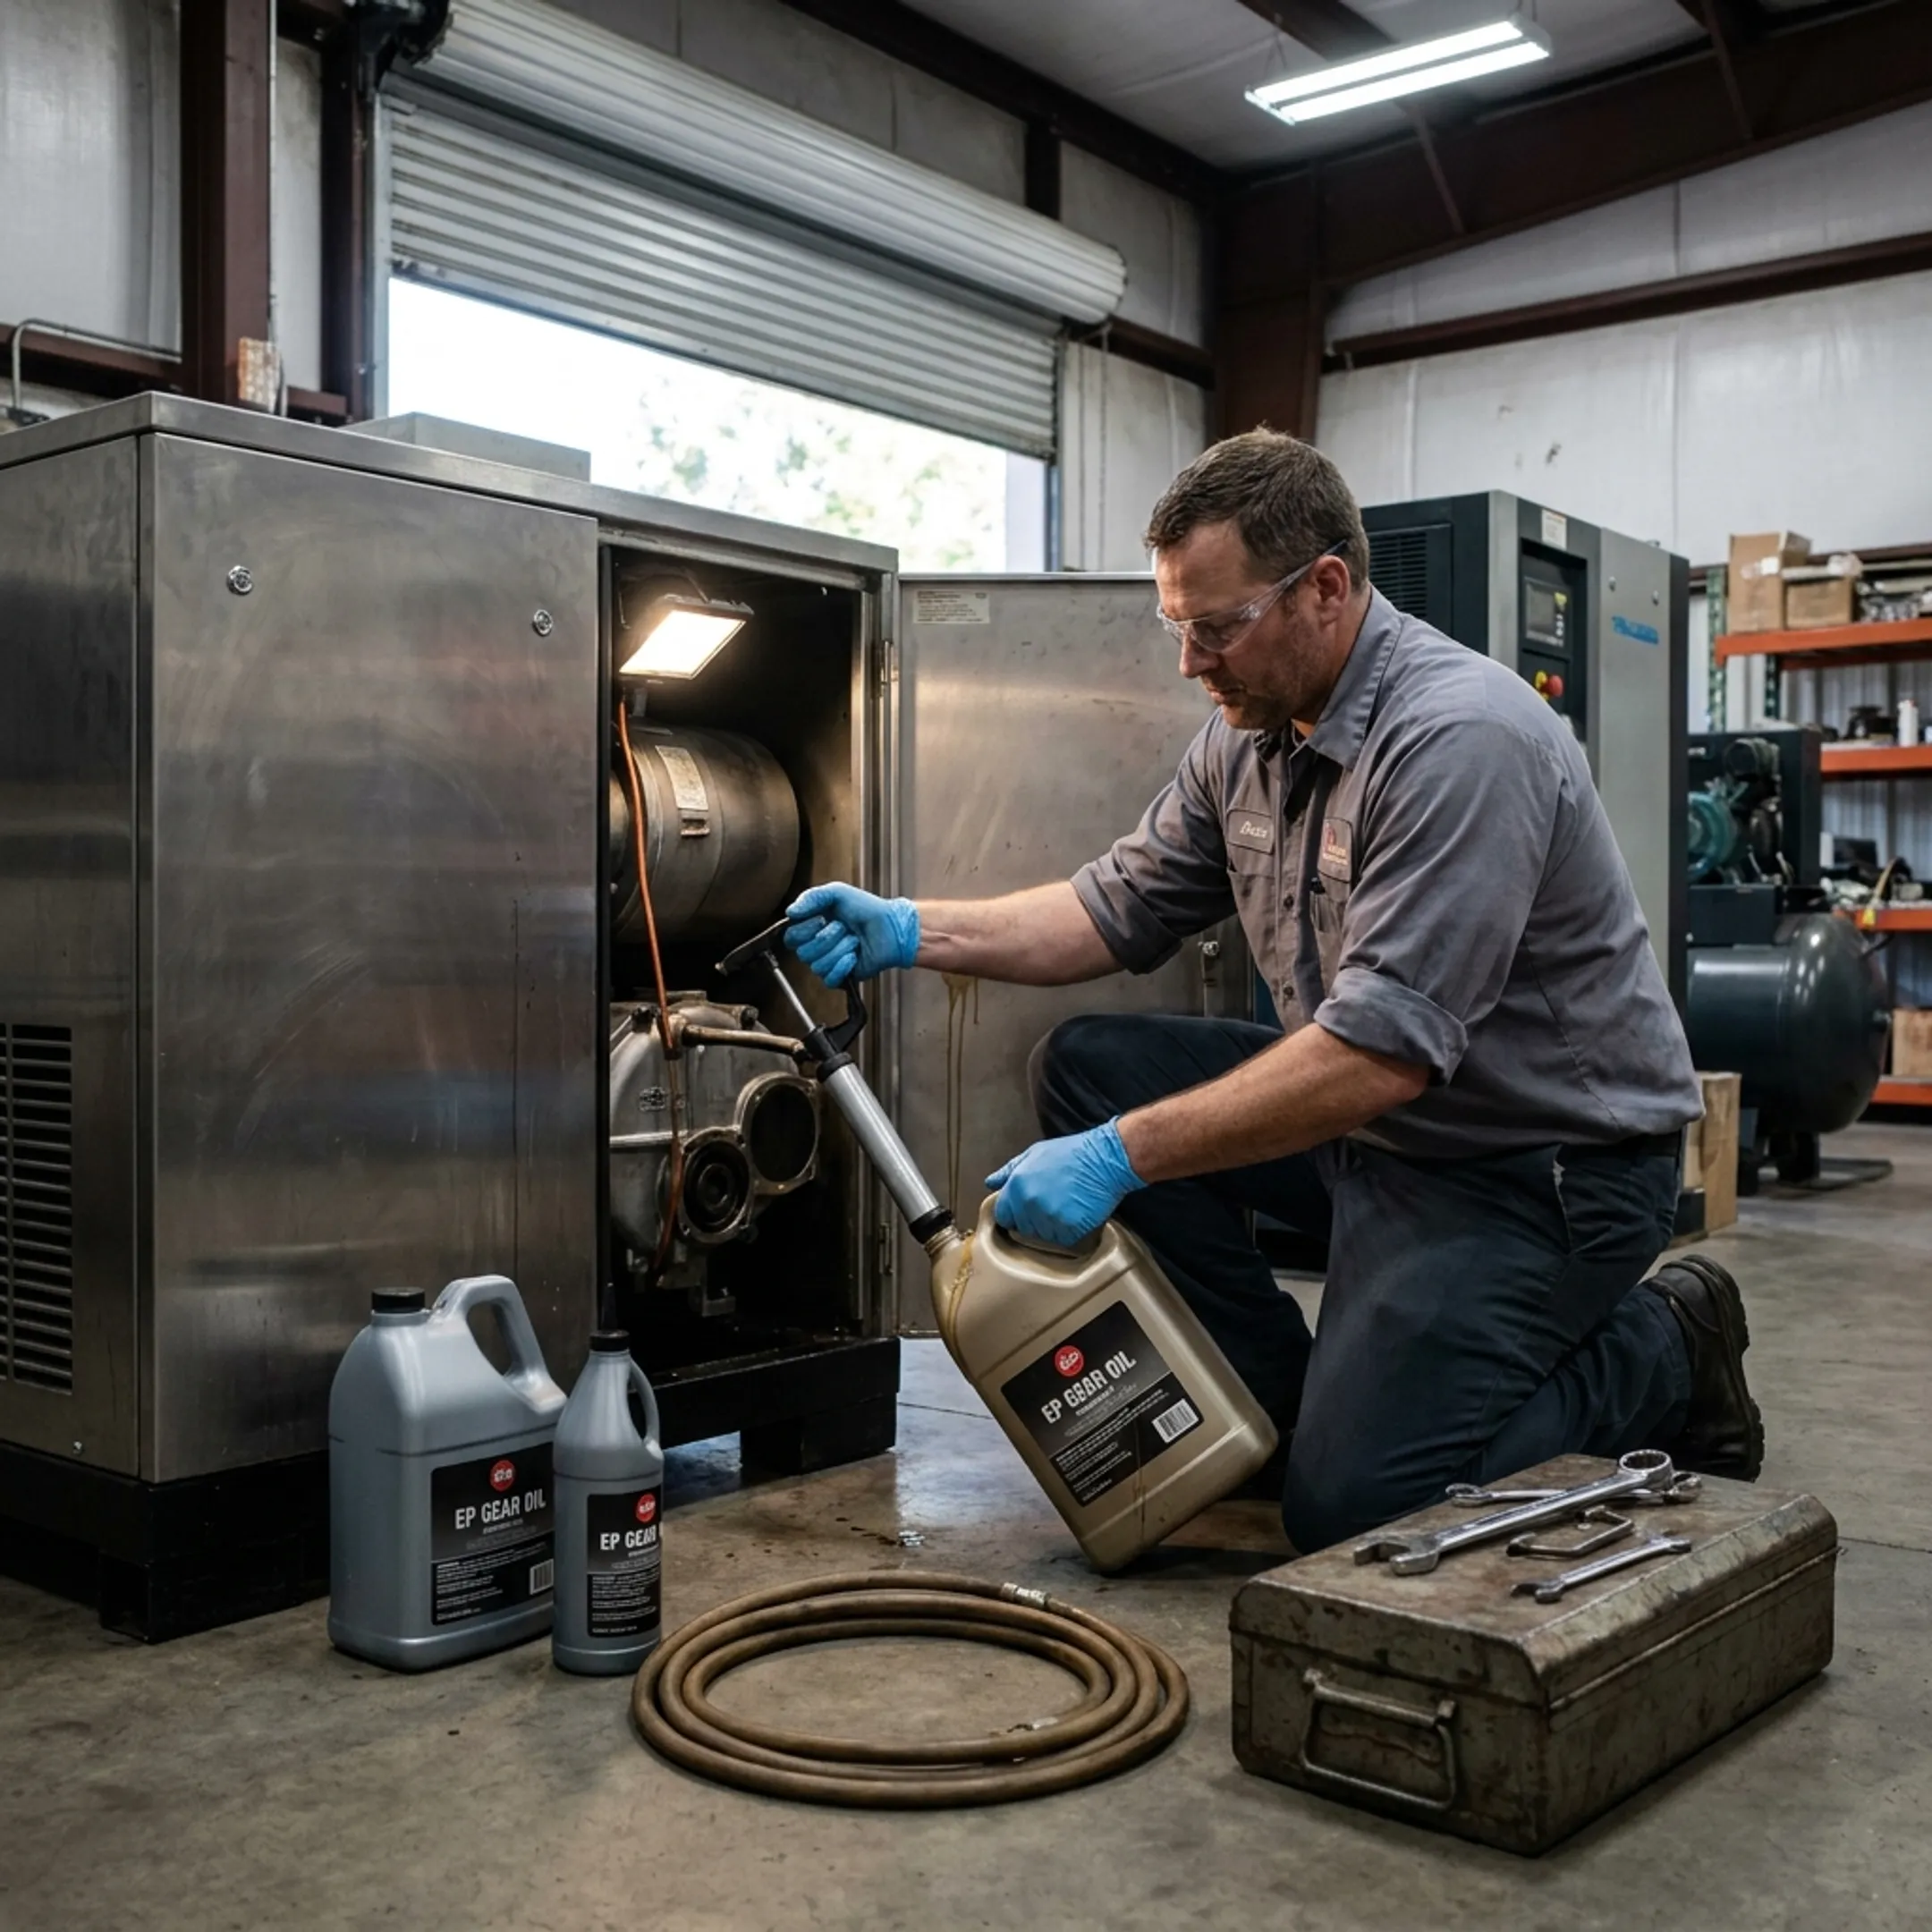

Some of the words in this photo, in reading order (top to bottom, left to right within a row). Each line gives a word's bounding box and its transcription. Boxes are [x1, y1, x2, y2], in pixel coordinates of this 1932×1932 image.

[1040, 1398, 1063, 1424] EP
[1104, 1351, 1137, 1378] OIL
[454, 1506, 476, 1530] EP
[481, 1496, 521, 1523] GEAR
[524, 1488, 547, 1512] OIL
[600, 1532, 620, 1550] EP
